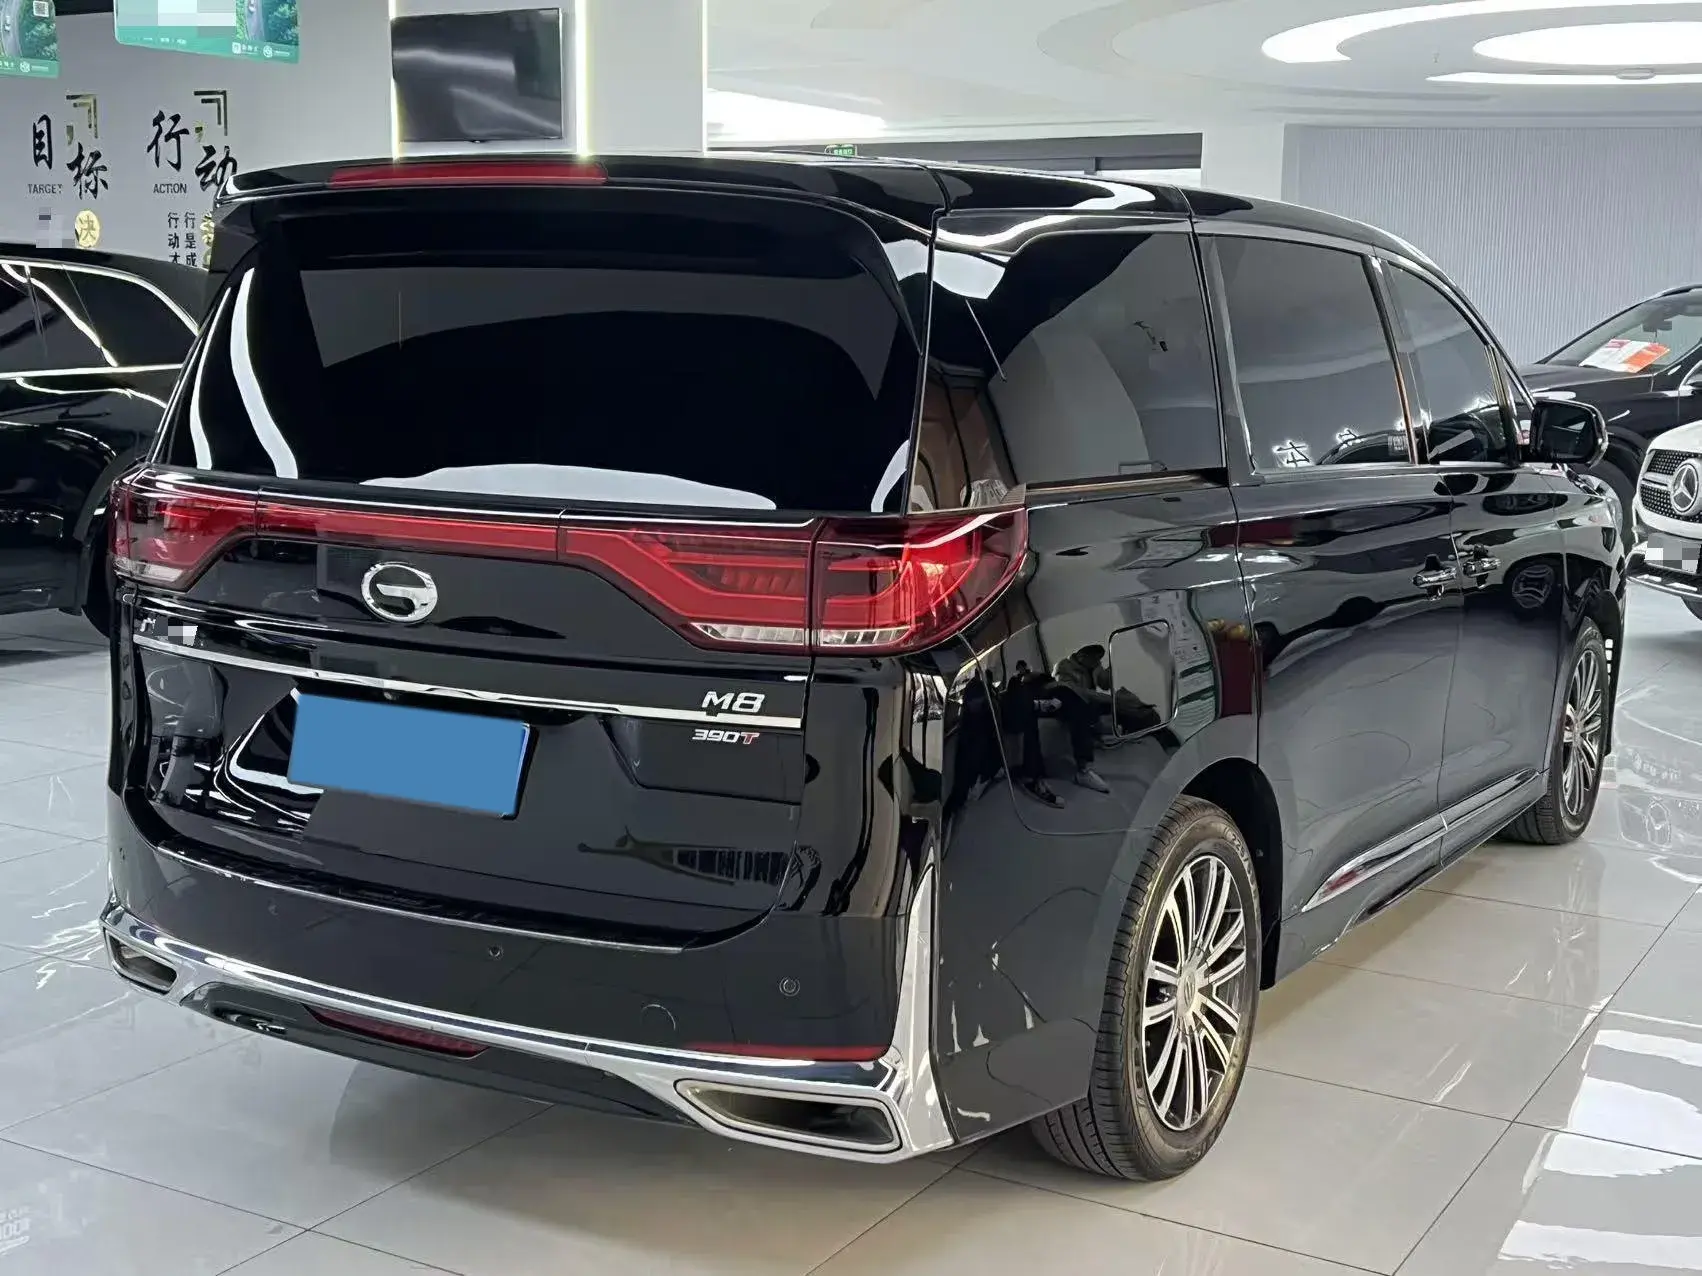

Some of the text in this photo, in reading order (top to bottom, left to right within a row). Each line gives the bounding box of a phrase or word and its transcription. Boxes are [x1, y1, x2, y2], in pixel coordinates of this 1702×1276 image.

[33, 114, 108, 200] 目标
[27, 183, 63, 195] TARGET
[153, 183, 187, 194] ACTION
[78, 214, 97, 242] 决
[701, 691, 765, 713] M8
[692, 728, 760, 745] 390T
